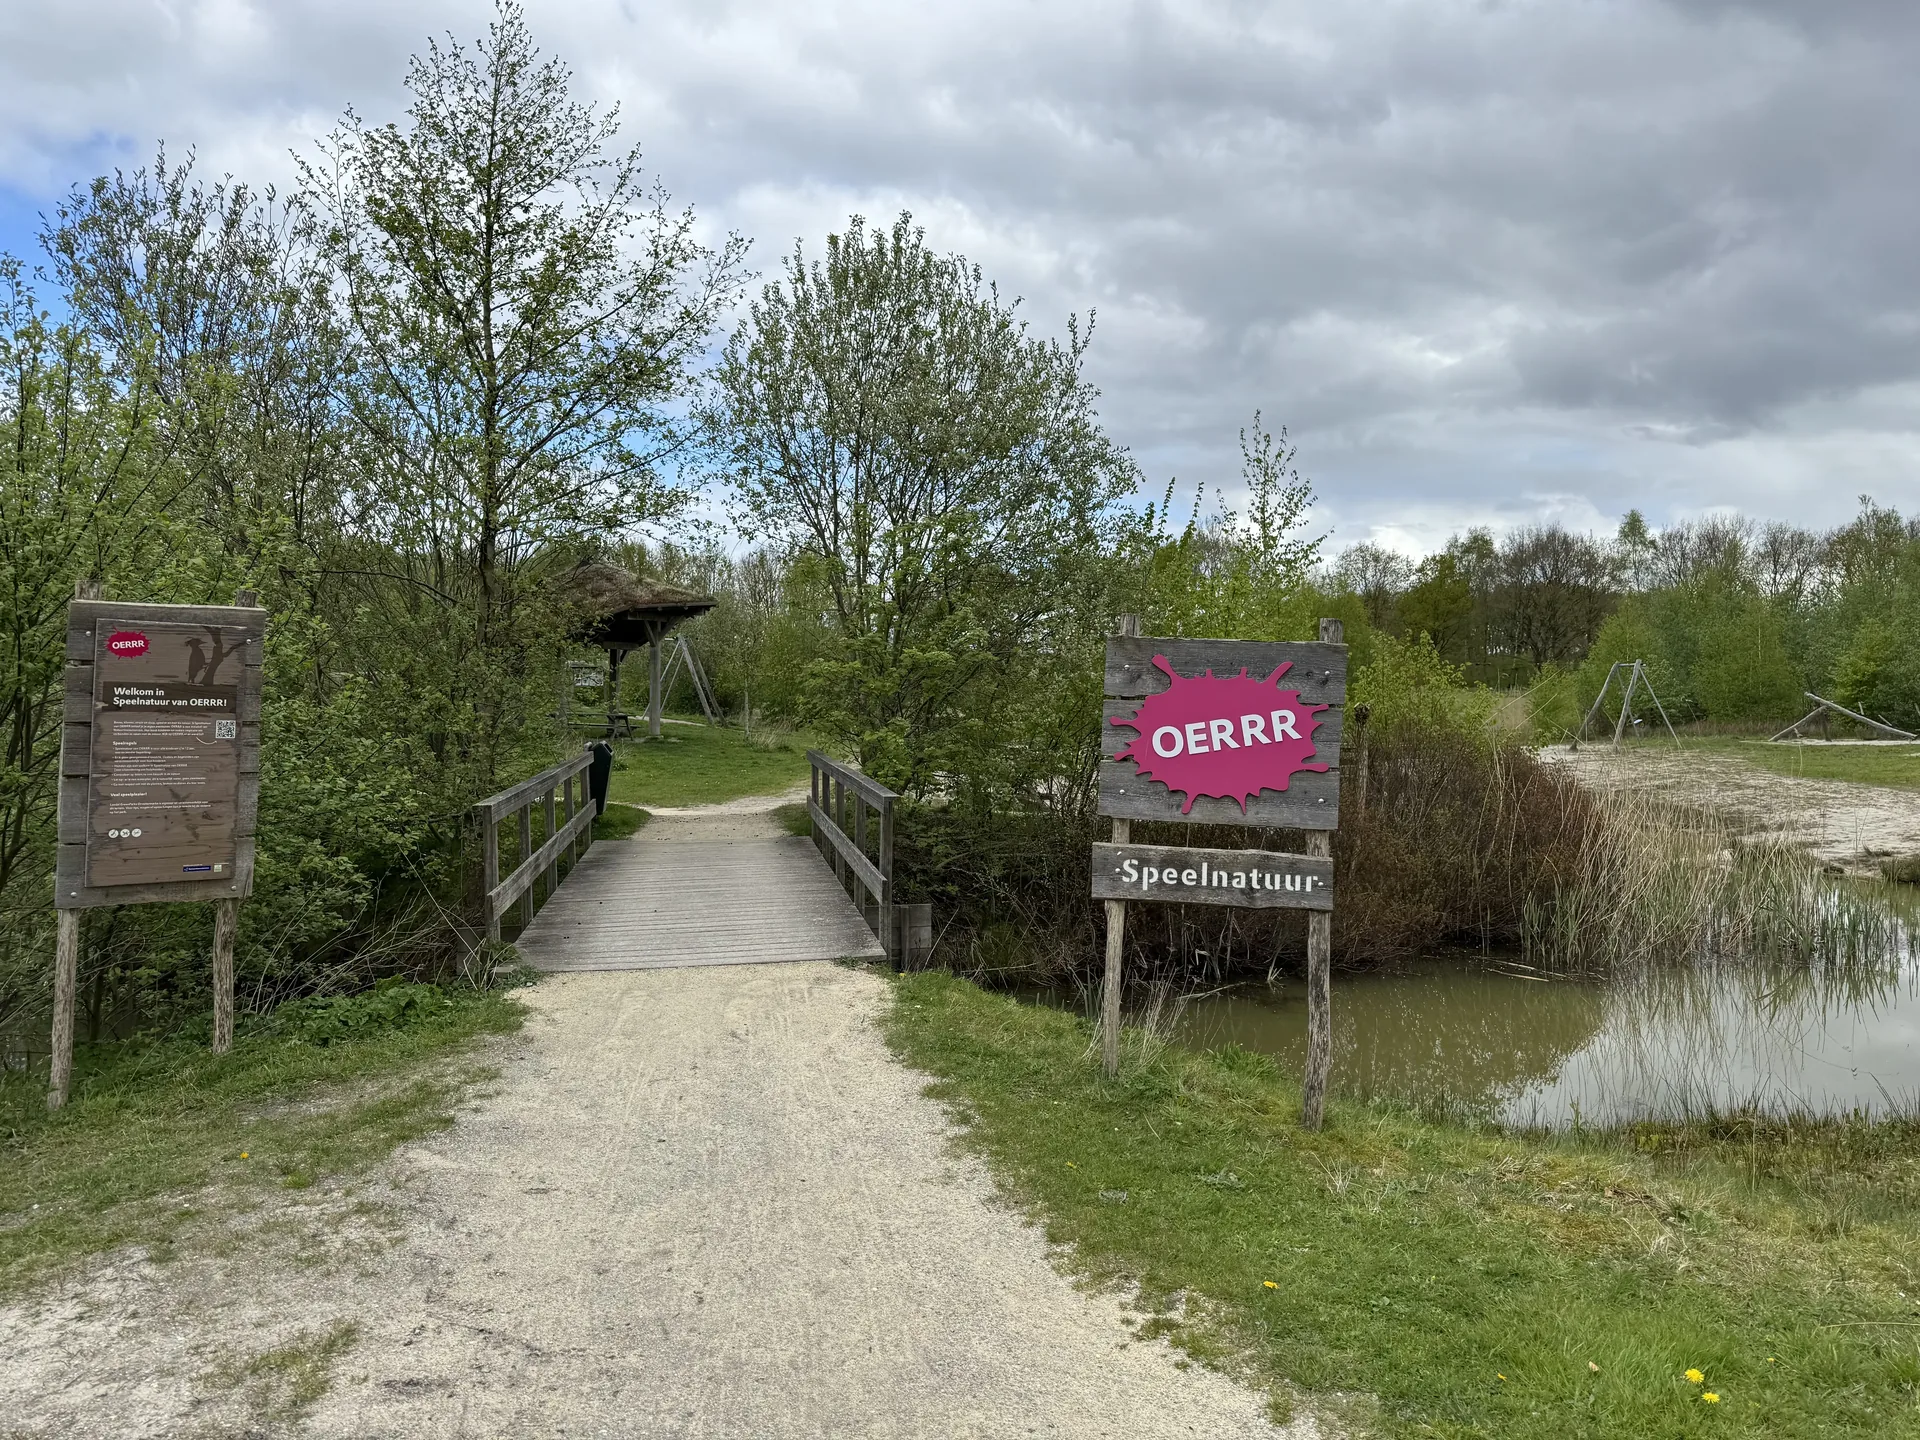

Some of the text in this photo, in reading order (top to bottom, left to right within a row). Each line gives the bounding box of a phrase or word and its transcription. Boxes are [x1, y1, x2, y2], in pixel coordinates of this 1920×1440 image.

[112, 640, 145, 649] OERRR
[113, 687, 165, 696] Welkom in
[113, 697, 227, 707] Speelnatuur van OERRR!
[1152, 709, 1303, 758] OERRR
[1121, 858, 1319, 892] Speelnatuur
